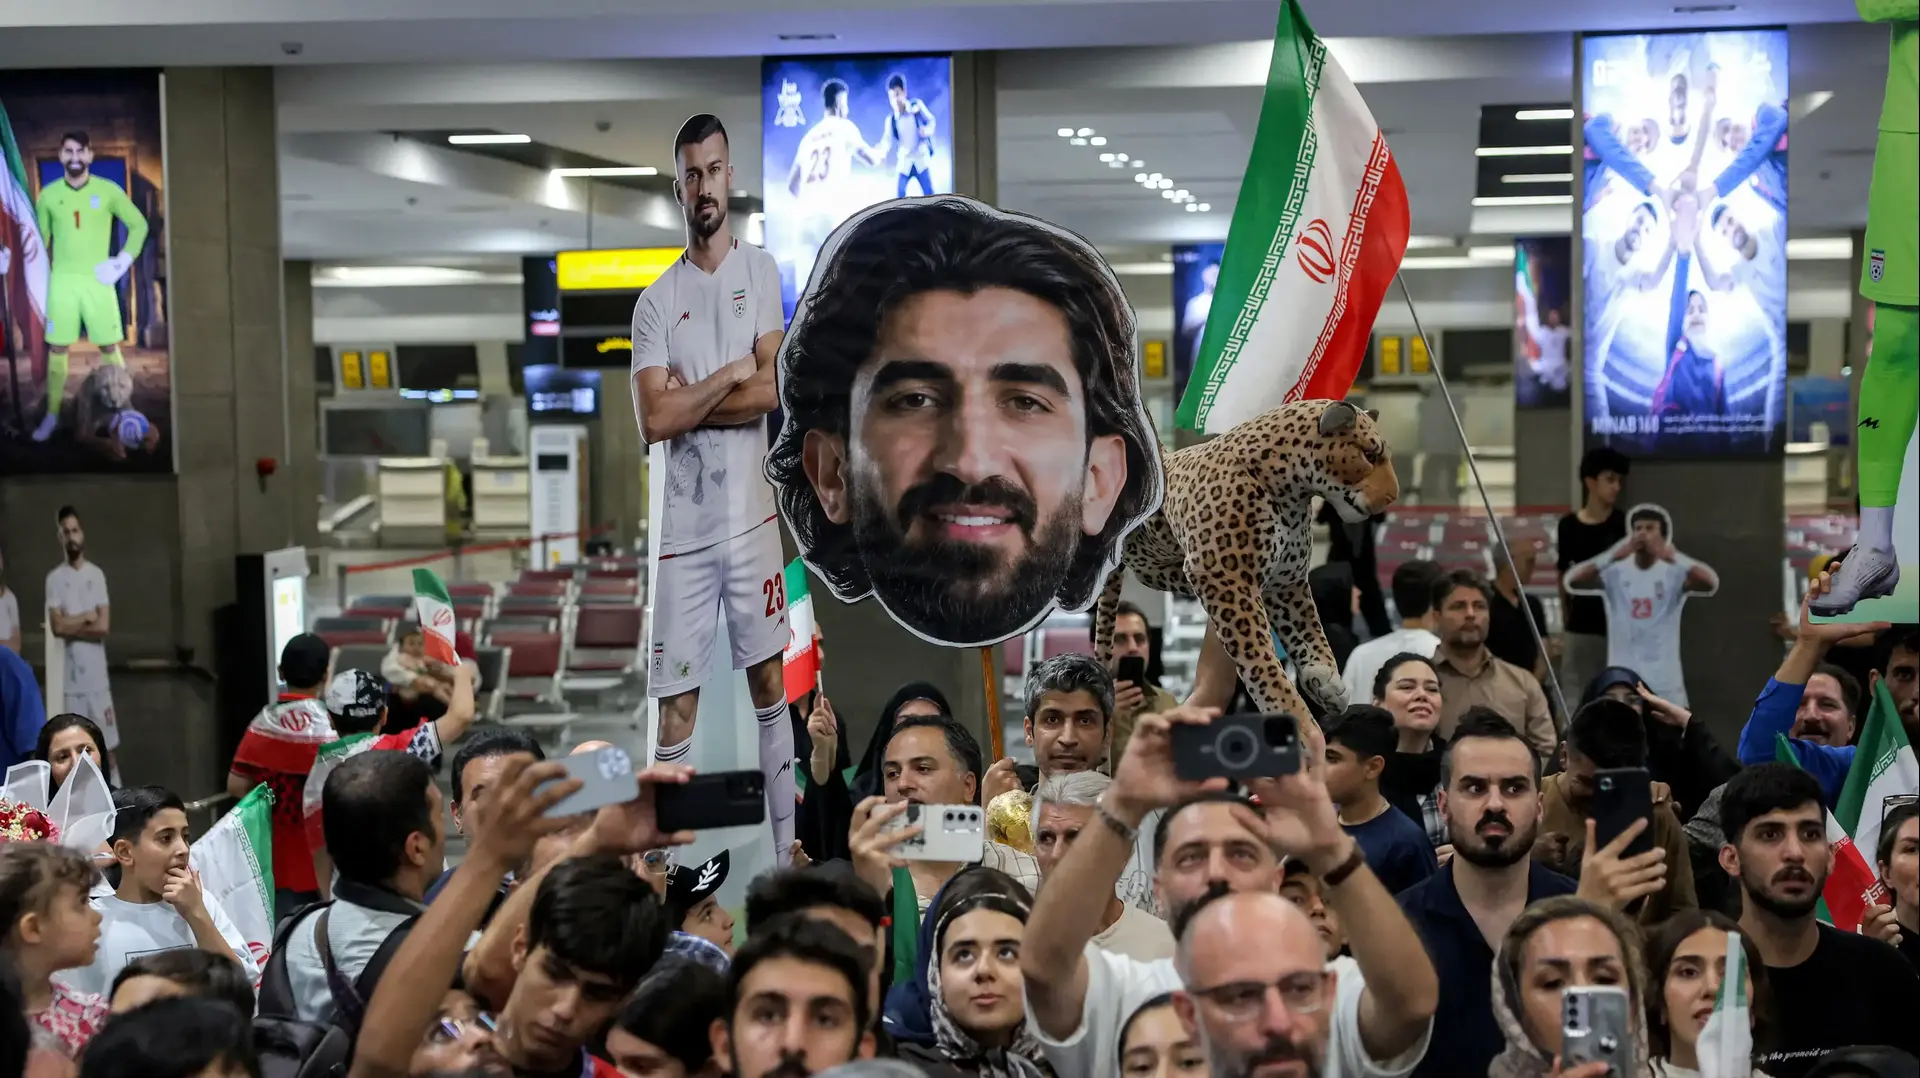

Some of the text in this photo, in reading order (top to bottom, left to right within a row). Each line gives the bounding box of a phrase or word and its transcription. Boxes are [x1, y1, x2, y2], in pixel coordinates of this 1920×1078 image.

[806, 146, 831, 183] 23
[73, 210, 81, 230] 1
[763, 572, 784, 618] 23
[1631, 598, 1652, 619] 23
[1769, 1051, 1783, 1061] the
